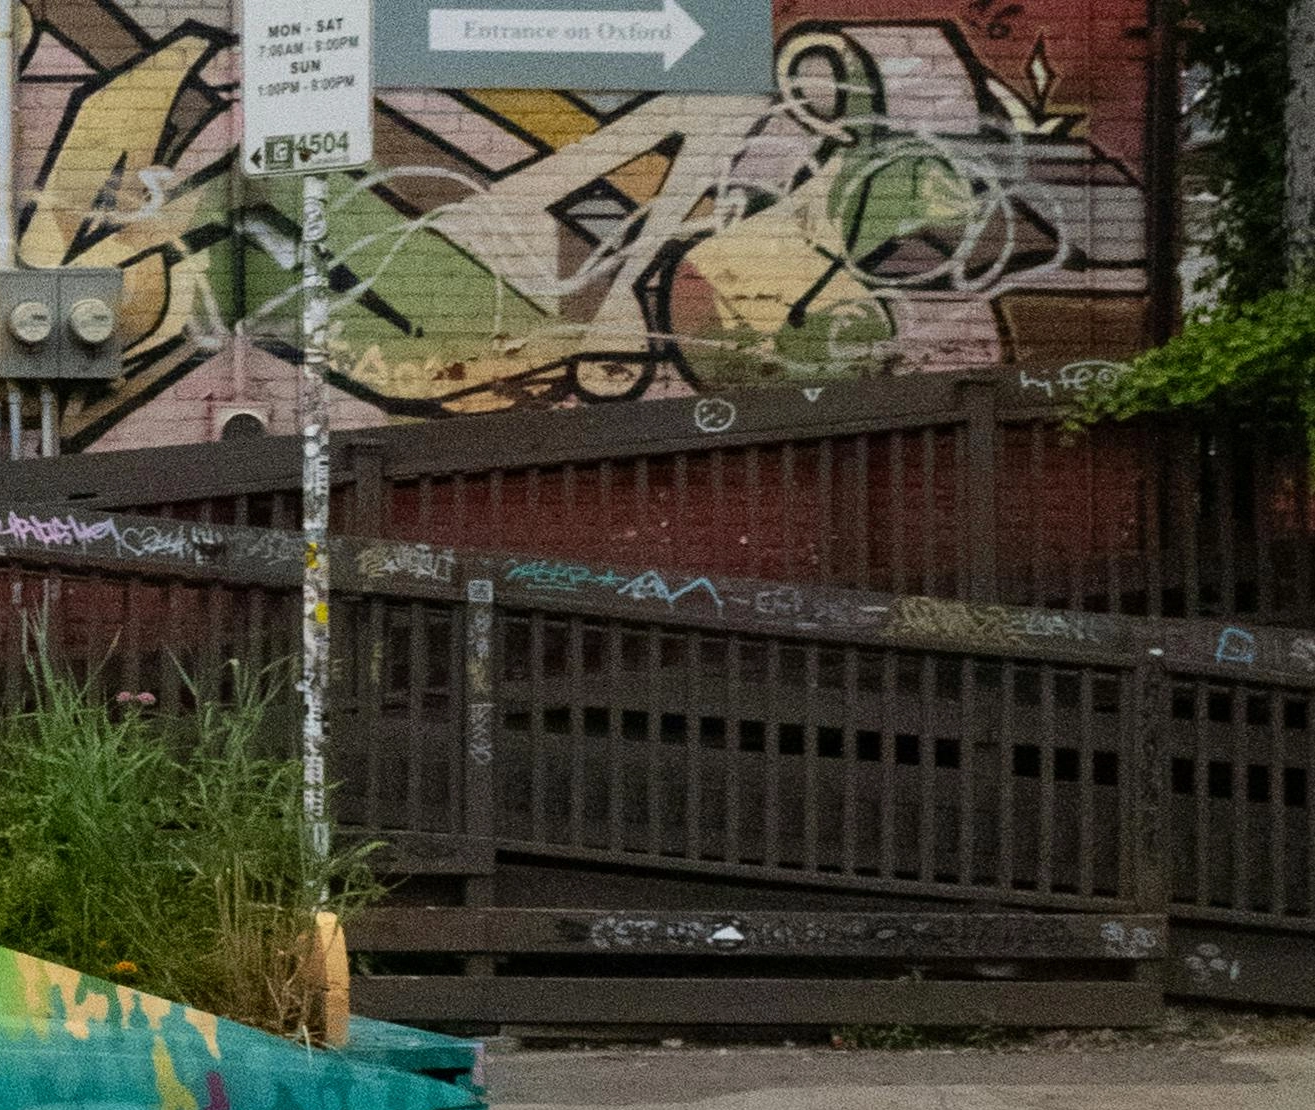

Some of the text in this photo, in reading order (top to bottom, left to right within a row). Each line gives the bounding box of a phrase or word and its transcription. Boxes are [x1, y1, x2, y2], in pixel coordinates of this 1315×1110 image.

[268, 22, 302, 38] MON
[316, 17, 344, 34] SAT
[463, 20, 672, 41] Entrance on Oxford
[290, 59, 321, 74] SUN
[295, 130, 350, 155] 4504
